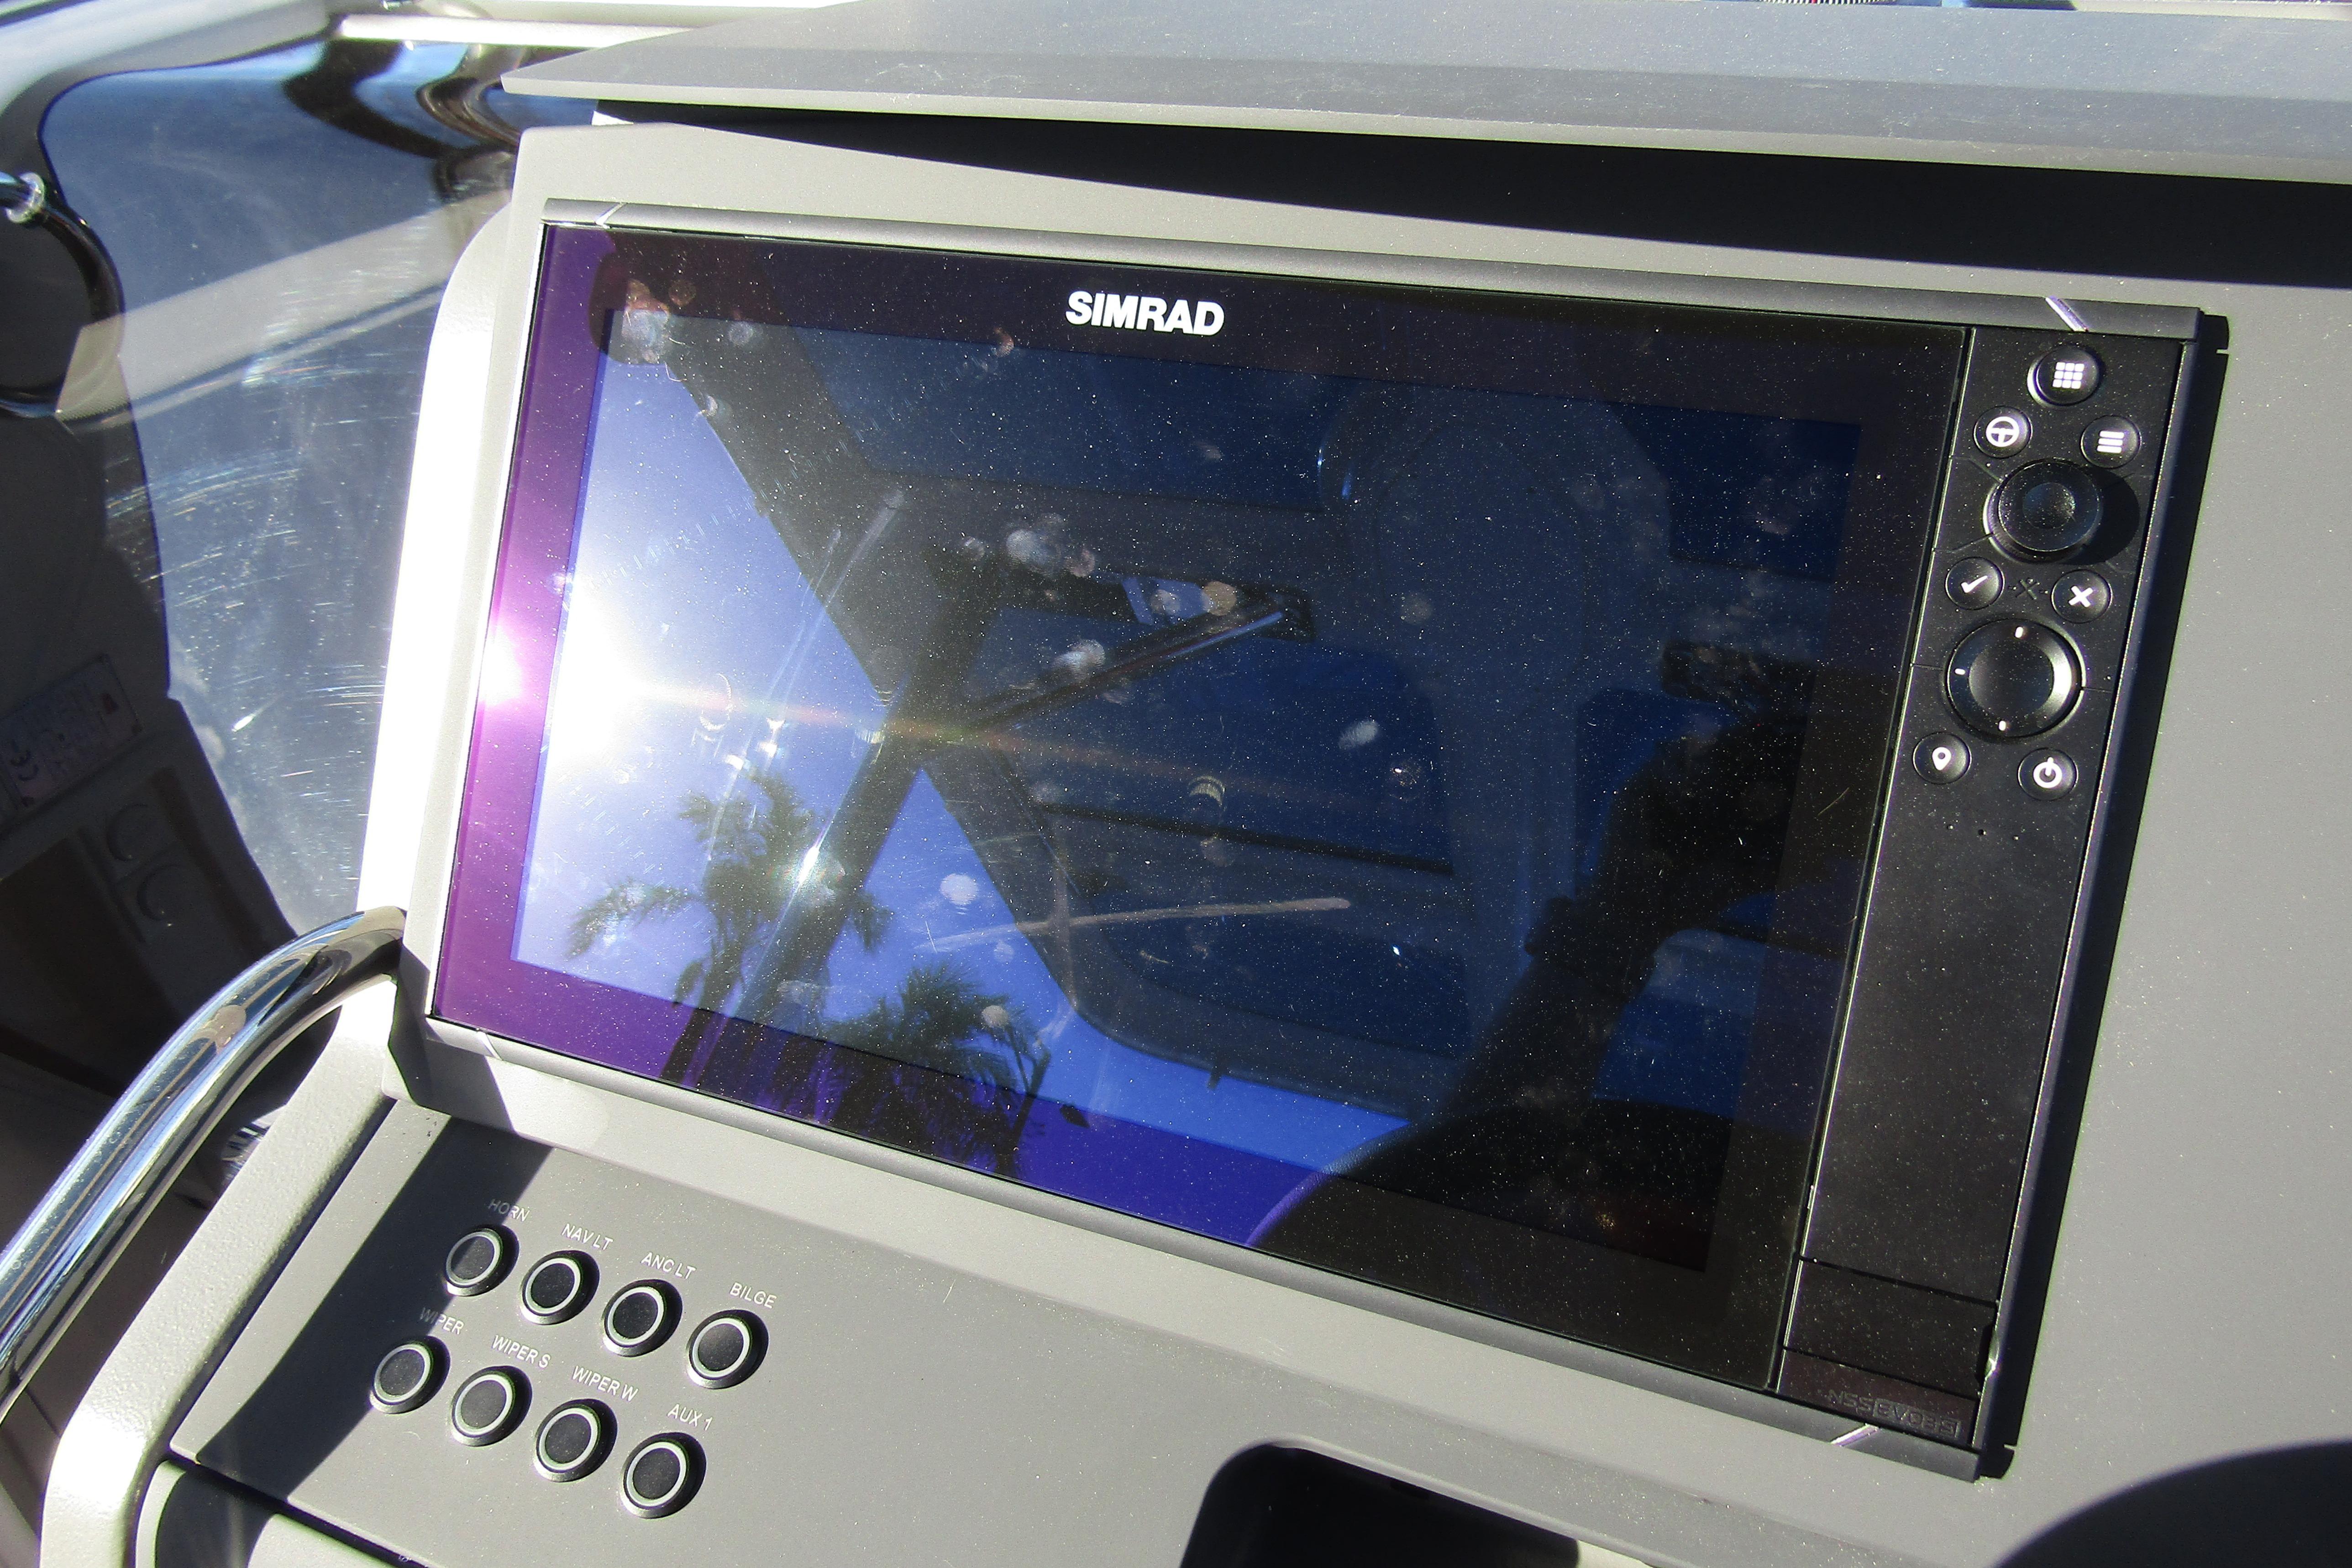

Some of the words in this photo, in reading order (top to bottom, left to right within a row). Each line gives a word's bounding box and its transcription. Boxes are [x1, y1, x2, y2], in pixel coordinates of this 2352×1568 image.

[1065, 291, 1225, 336] SIMRAD
[488, 1198, 530, 1222] HORN
[561, 1223, 594, 1243] NAV
[593, 1234, 614, 1250] LT
[640, 1252, 675, 1273] ANC
[675, 1263, 697, 1279] LT
[730, 1282, 777, 1309] BILGE
[419, 1307, 464, 1335] WIPER
[491, 1335, 539, 1364] WIPER
[538, 1353, 551, 1368] S
[572, 1365, 620, 1395] WIPER
[621, 1384, 639, 1402] W
[667, 1404, 703, 1427] AUX
[704, 1416, 713, 1431] 1
